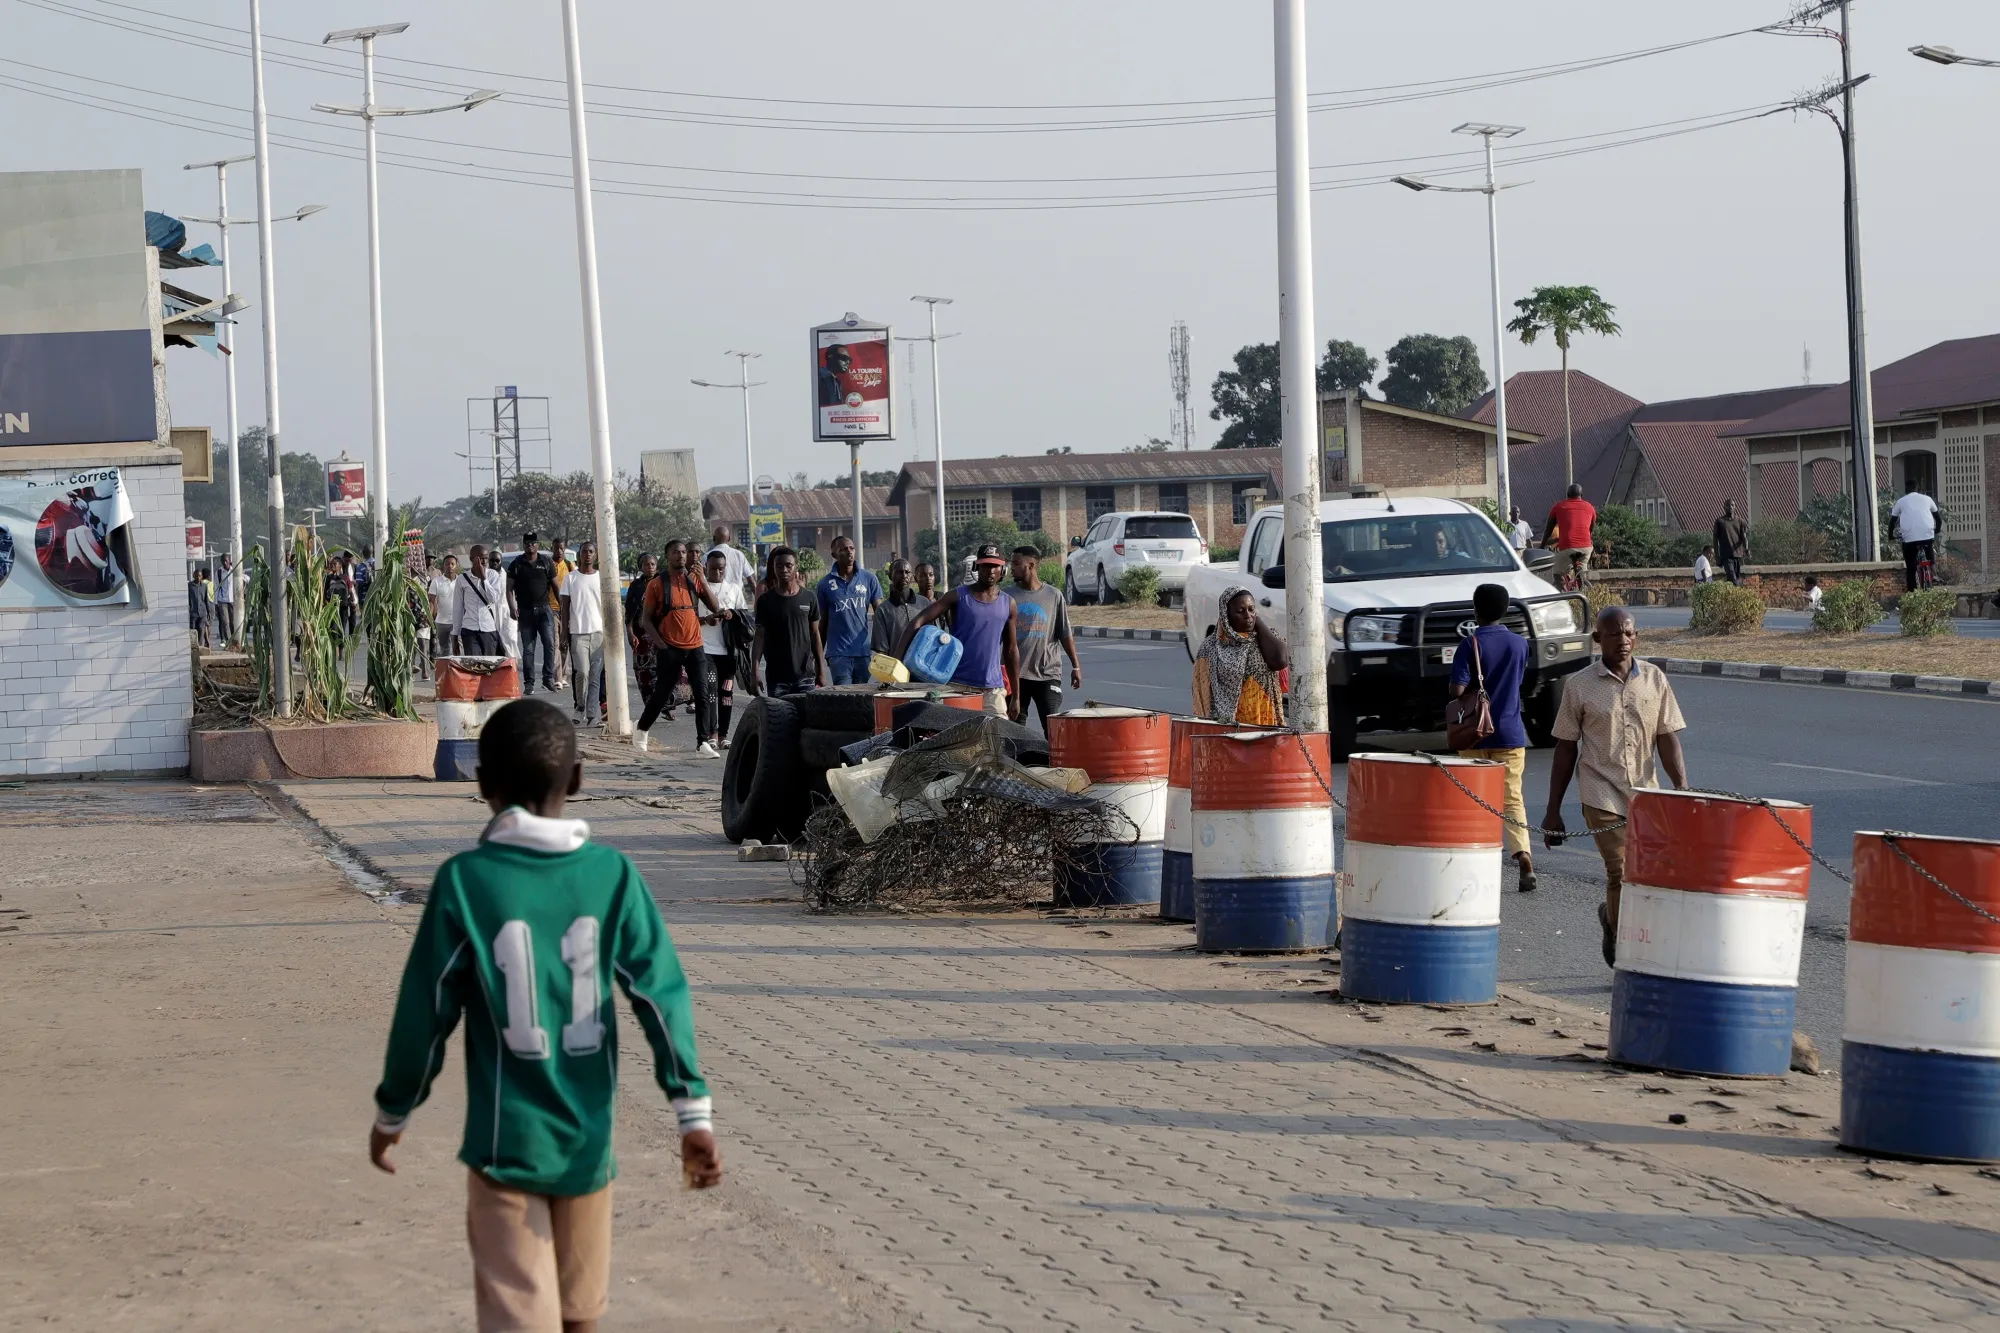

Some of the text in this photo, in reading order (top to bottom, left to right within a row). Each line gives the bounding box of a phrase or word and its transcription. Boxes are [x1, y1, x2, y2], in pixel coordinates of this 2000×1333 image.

[828, 578, 839, 591] 3
[834, 596, 867, 612] LXVII
[492, 916, 606, 1059] 11
